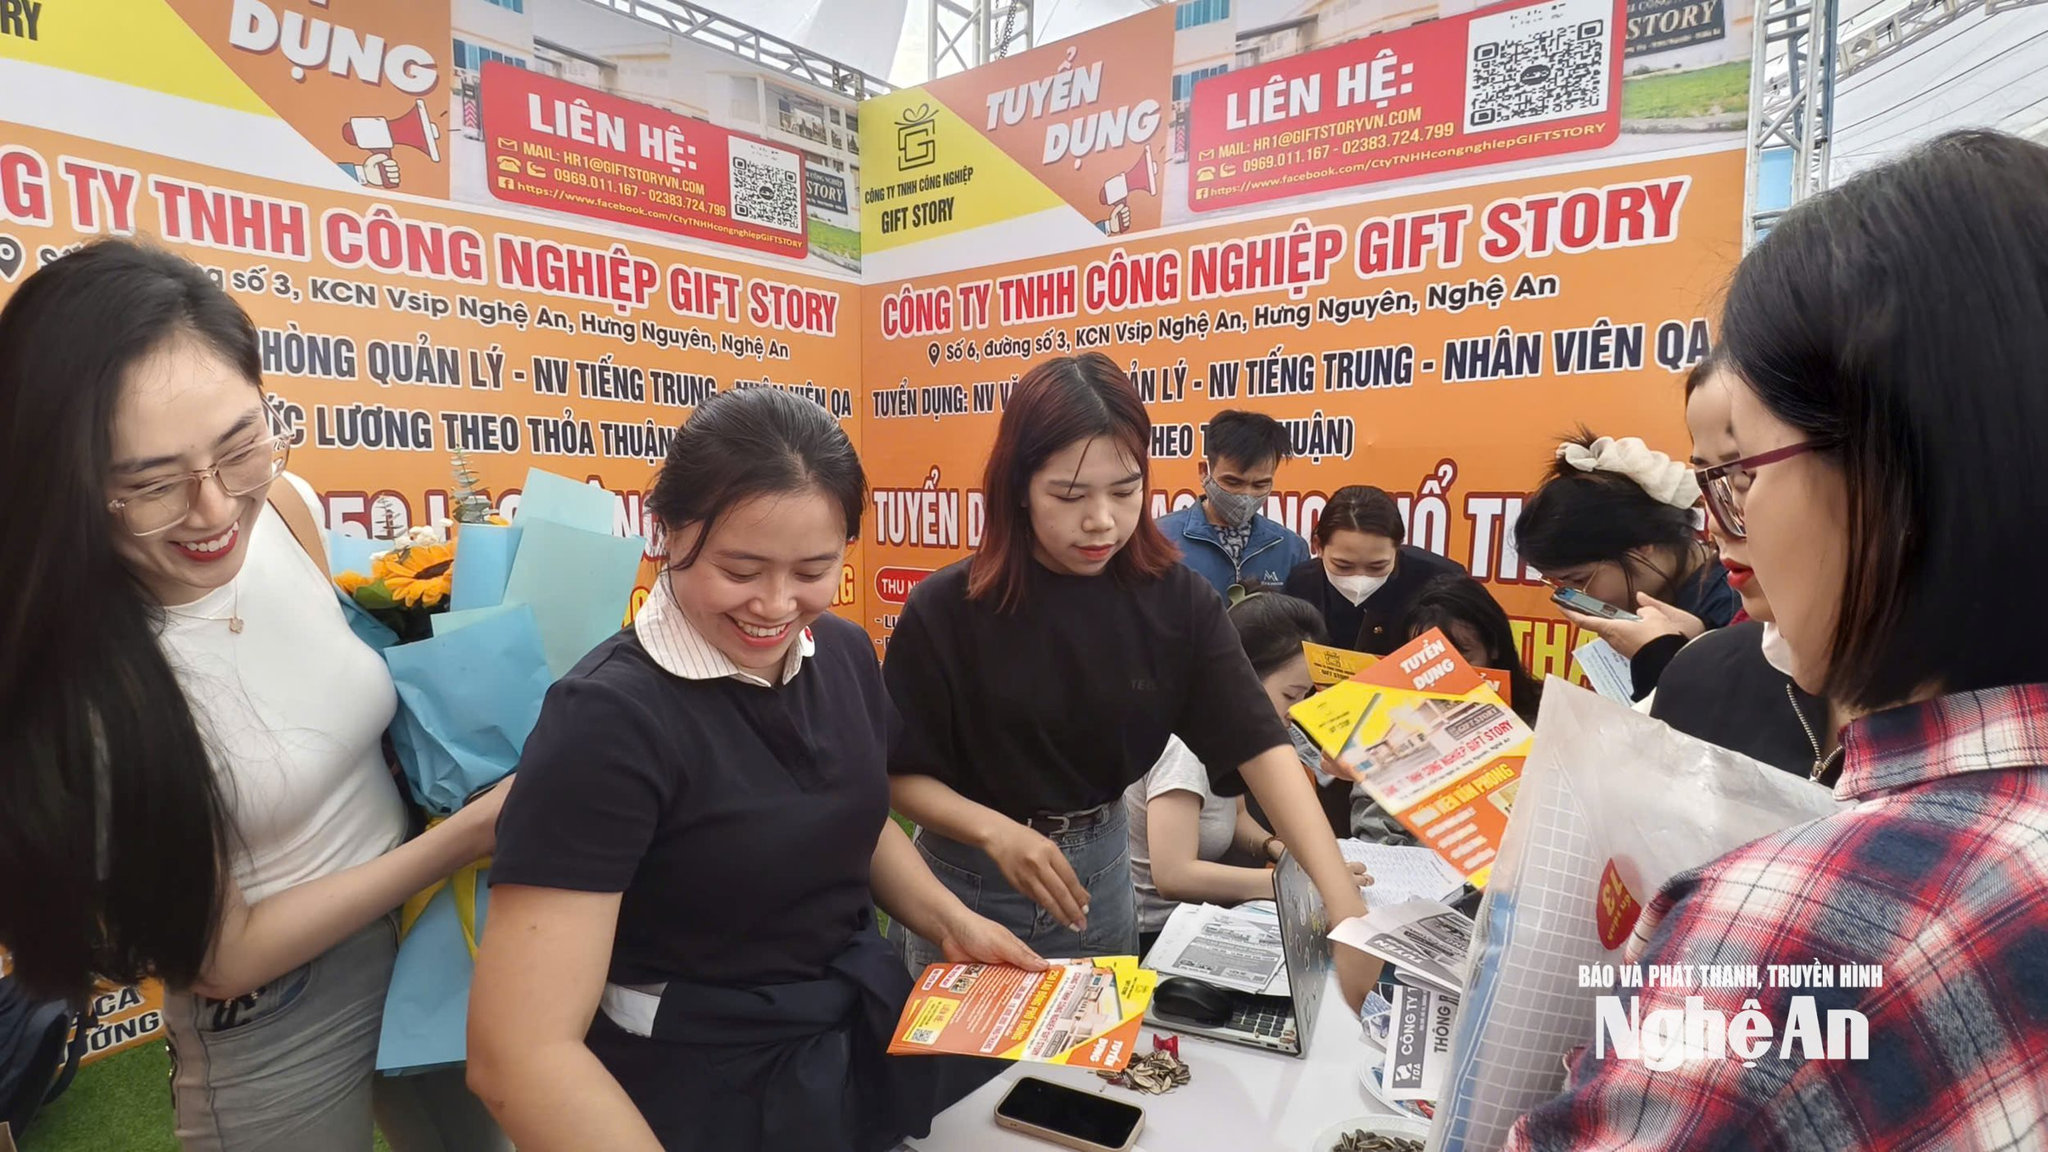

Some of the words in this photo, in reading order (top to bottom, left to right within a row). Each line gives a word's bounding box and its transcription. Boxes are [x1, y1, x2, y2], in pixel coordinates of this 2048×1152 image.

[229, 0, 438, 93] DỤNG
[986, 46, 1103, 130] TUYỂN
[1226, 74, 1321, 131] LIÊN
[1337, 47, 1414, 109] HỆ:
[528, 92, 626, 152] LIÊN
[639, 123, 697, 174] HỆ:
[1042, 99, 1161, 170] DỤNG
[1219, 142, 1250, 159] MAIL:
[1254, 107, 1422, 151] HR1@GIFTSTORYVN.COM
[1243, 145, 1330, 173] 0969.011.167
[1342, 122, 1455, 155] 02383.724.799
[523, 141, 560, 162] MAIL:
[564, 151, 705, 196] HR1@GIFTSTORYVN.COM
[554, 167, 638, 198] 0969.011.167
[649, 188, 727, 218] 02383.724.799
[806, 180, 843, 202] STORY
[886, 185, 898, 199] TY
[897, 180, 917, 197] TNHH
[943, 165, 974, 186] NGHIỆP
[881, 207, 909, 234] GIFT
[912, 196, 955, 228] STORY
[65, 162, 135, 231] TY
[155, 180, 306, 256] TNHH
[326, 208, 482, 280] CÔNG
[500, 237, 657, 311] NGHIỆP
[670, 268, 739, 318] GIFT
[750, 282, 839, 333] STORY
[883, 286, 951, 336] CÔNG
[959, 284, 990, 327] TY
[999, 270, 1075, 322] TNHH
[1086, 252, 1178, 310] CÔNG
[1191, 224, 1342, 296] NGHIỆP
[1359, 209, 1468, 275] GIFT
[1484, 180, 1685, 258] STORY
[233, 267, 267, 292] số
[274, 274, 300, 300] 3,
[311, 278, 377, 306] KCN
[387, 288, 450, 318] Vsip
[459, 296, 529, 329] Nghệ
[537, 309, 574, 334] An,
[582, 313, 636, 342] Hưng
[642, 322, 717, 352] Nguyên,
[721, 334, 764, 360] Nghệ
[769, 341, 789, 359] An
[946, 339, 963, 360] Số
[966, 344, 980, 361] 6,
[984, 336, 1031, 358] đường
[1035, 329, 1053, 352] số
[1056, 331, 1070, 353] 3,
[1075, 325, 1110, 347] KCN
[1115, 320, 1151, 344] Vsip
[1158, 313, 1209, 342] Nghệ
[1215, 312, 1248, 333] An,
[1254, 304, 1310, 328] Hưng
[1318, 291, 1419, 323] Nguyên,
[1428, 278, 1504, 311] Nghệ
[1514, 274, 1557, 300] An
[261, 323, 356, 378] HÒNG
[369, 334, 460, 387] QUẢN
[470, 345, 504, 389] LÝ
[533, 357, 569, 394] NV
[576, 354, 644, 402] TIẾNG
[650, 371, 716, 406] TRUNG
[1162, 360, 1187, 401] LÝ
[1209, 362, 1239, 398] NV
[1245, 344, 1314, 395] TIẾNG
[1323, 346, 1413, 390] TRUNG
[1444, 328, 1542, 381] NHÂN
[1554, 319, 1643, 372] VIÊN
[1657, 320, 1711, 370] QA
[830, 389, 852, 418] QA
[873, 378, 917, 417] TUYỂN
[922, 387, 968, 421] DỤNG:
[973, 383, 995, 412] NV
[268, 395, 304, 446] ỨC
[316, 405, 432, 449] LƯƠNG
[442, 413, 519, 450] THEO
[526, 410, 595, 455] THỎA
[600, 420, 675, 464] THUẬN
[1151, 425, 1193, 457] HEO
[873, 468, 958, 547] TUYỂN
[882, 578, 904, 594] THU
[1400, 638, 1446, 674] TUYỂN
[1412, 658, 1455, 691] DỤNG
[1484, 719, 1513, 741] STORY
[1406, 995, 1418, 1010] TY
[1400, 1013, 1416, 1055] CÔNG
[1432, 1006, 1451, 1053] THÔNG
